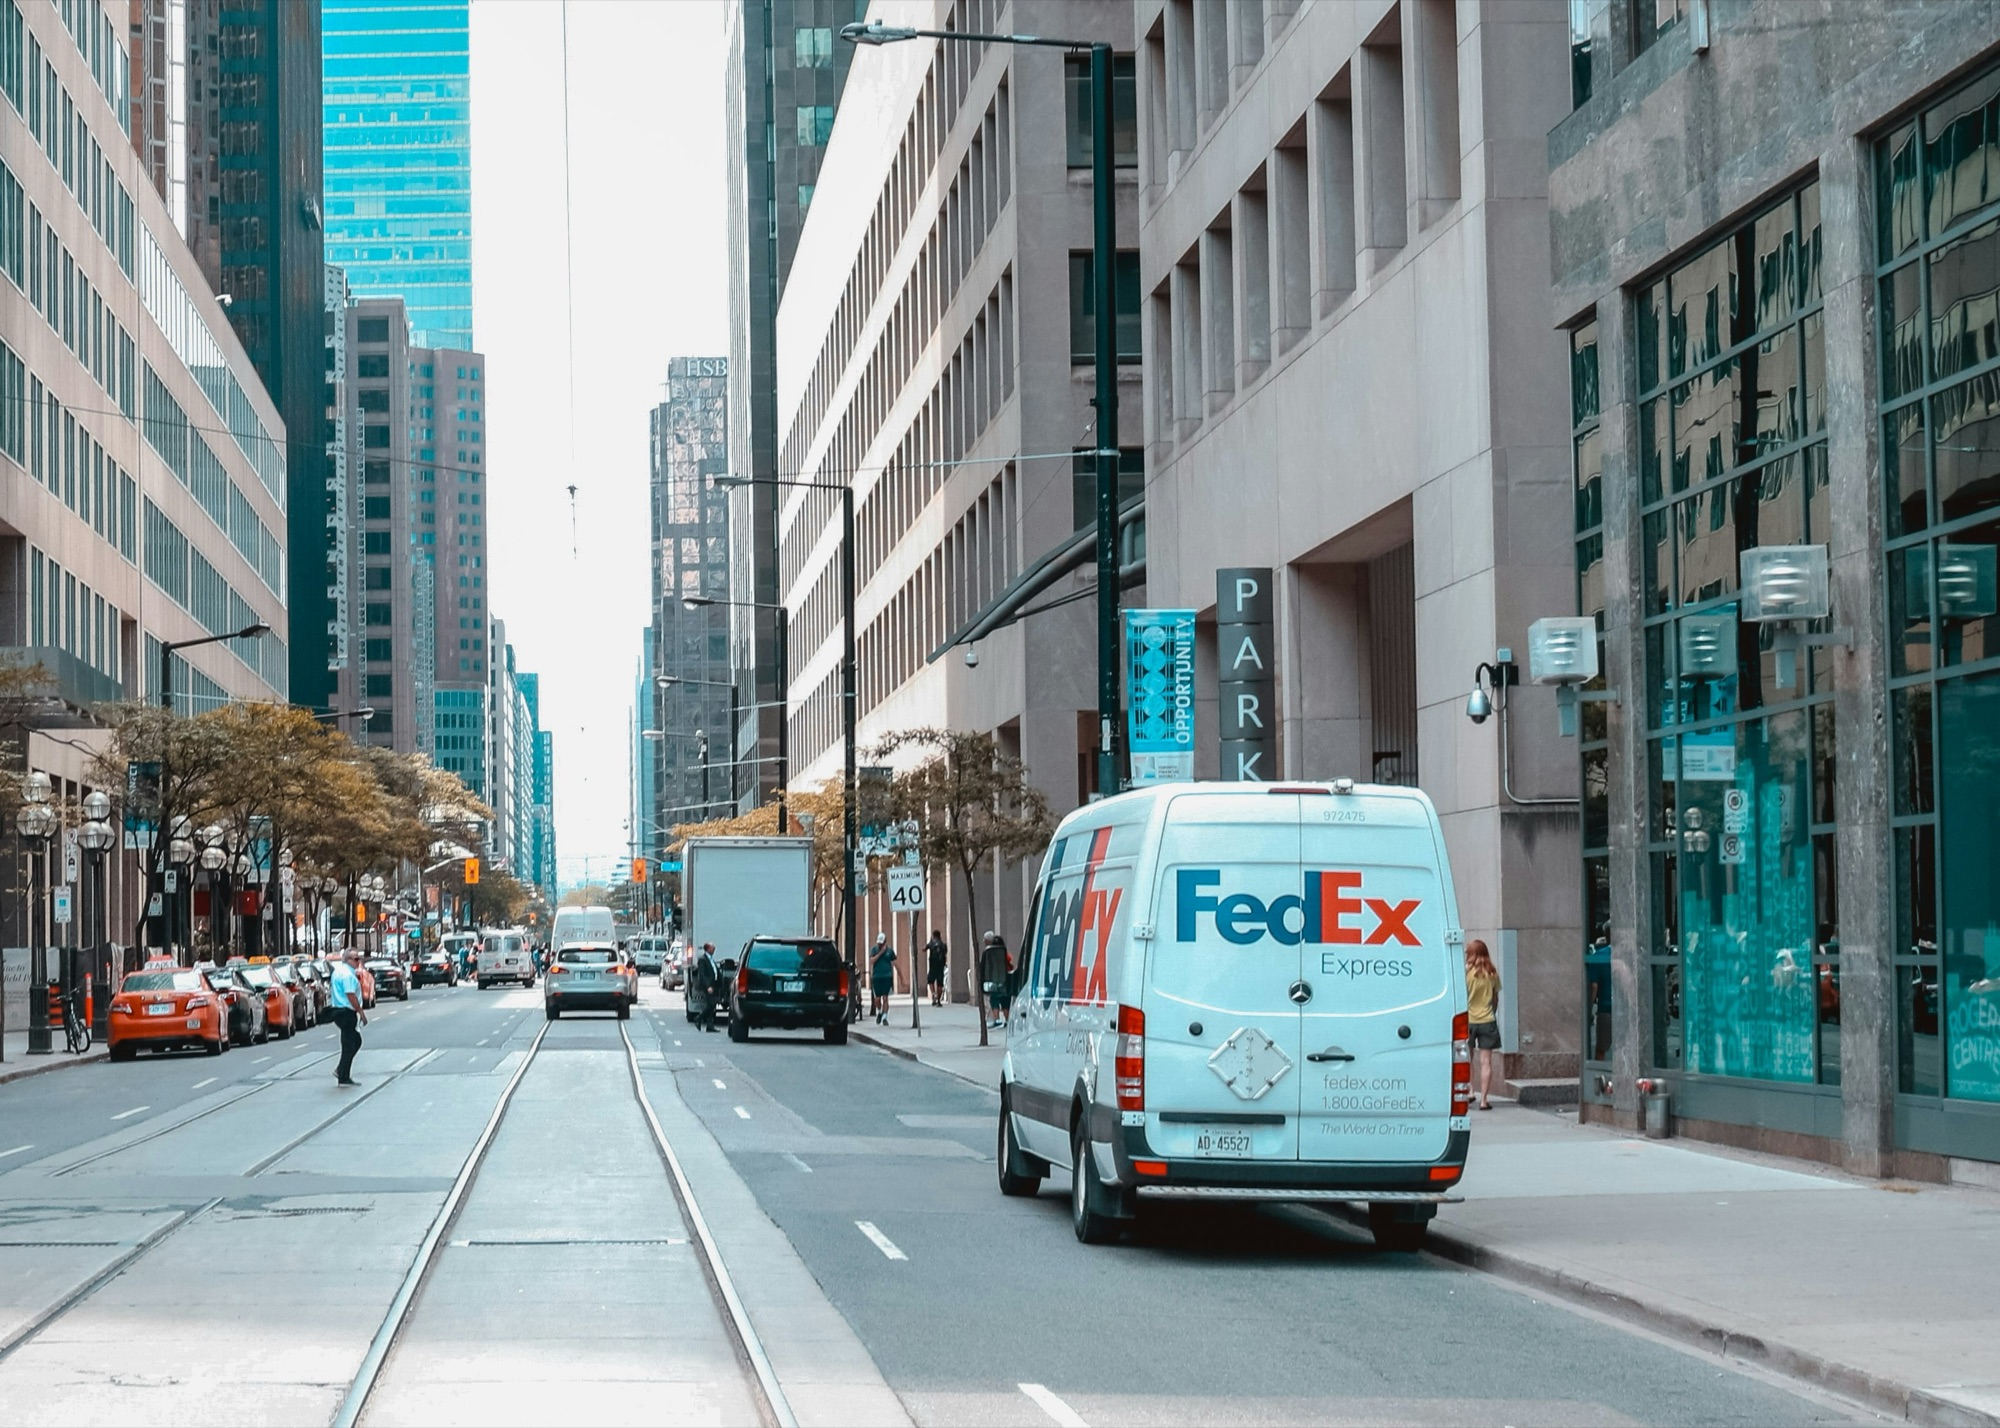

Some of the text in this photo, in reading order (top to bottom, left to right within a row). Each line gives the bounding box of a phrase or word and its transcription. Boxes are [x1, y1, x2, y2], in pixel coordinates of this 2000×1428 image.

[1175, 618, 1192, 744] OPPORTUNITY
[1232, 578, 1264, 782] PARK
[1323, 810, 1366, 822] 972475
[890, 871, 921, 879] MAXIMUM
[892, 885, 923, 906] 40
[1031, 826, 1124, 1010] FedEx
[1176, 869, 1423, 947] FedEx
[1321, 952, 1413, 980] Express
[1948, 997, 2000, 1042] ROGER
[1324, 1074, 1407, 1090] fedex.com
[1322, 1095, 1425, 1110] 1.800.GoFedEx
[1321, 1123, 1425, 1135] The World On Time
[1217, 1136, 1250, 1151] 45527
